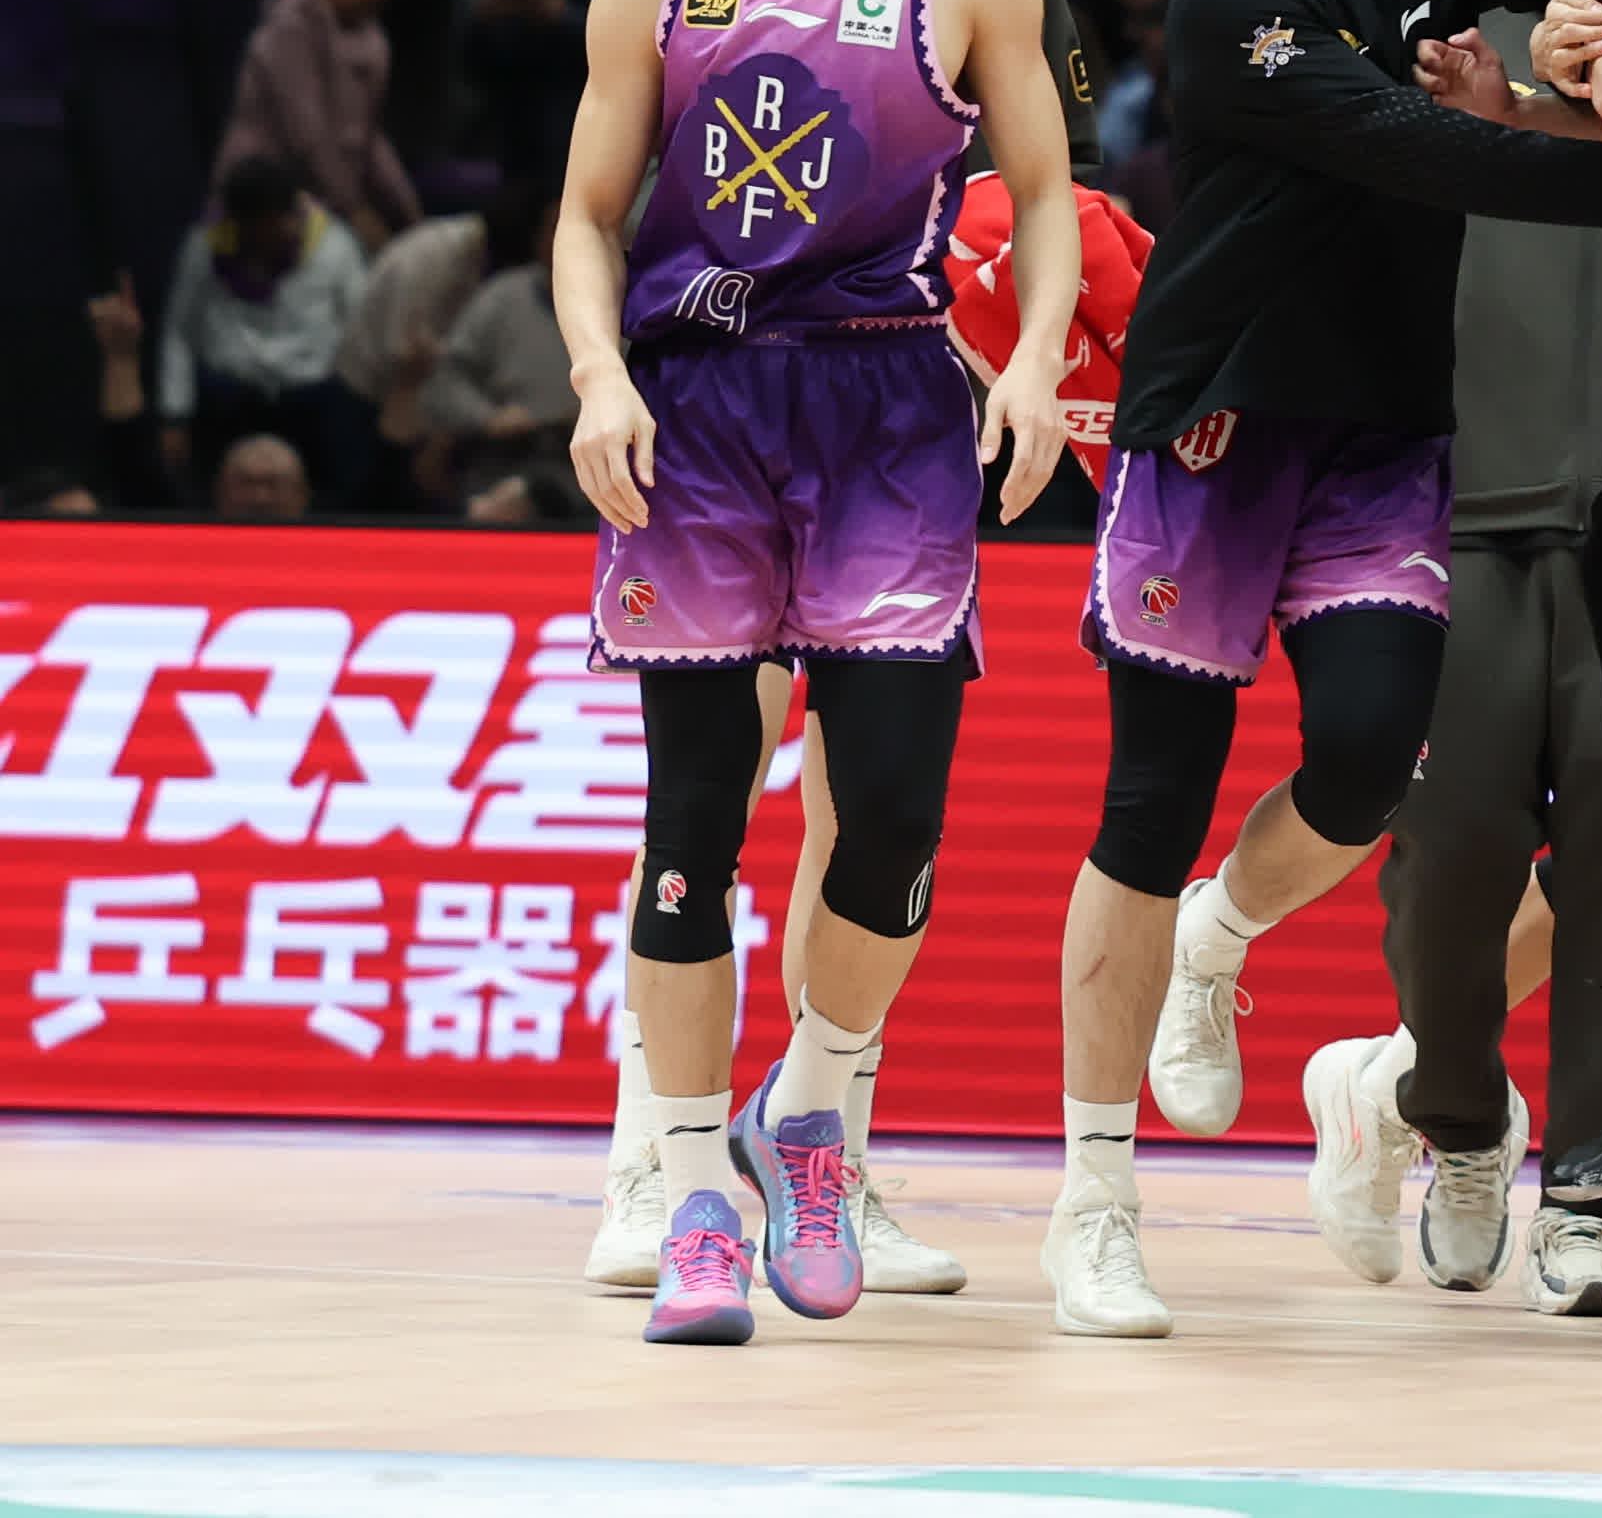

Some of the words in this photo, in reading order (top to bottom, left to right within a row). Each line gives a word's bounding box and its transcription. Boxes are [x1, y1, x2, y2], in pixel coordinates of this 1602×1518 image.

[752, 75, 785, 131] R
[704, 123, 729, 178] B
[801, 137, 835, 190] J
[739, 185, 776, 238] F
